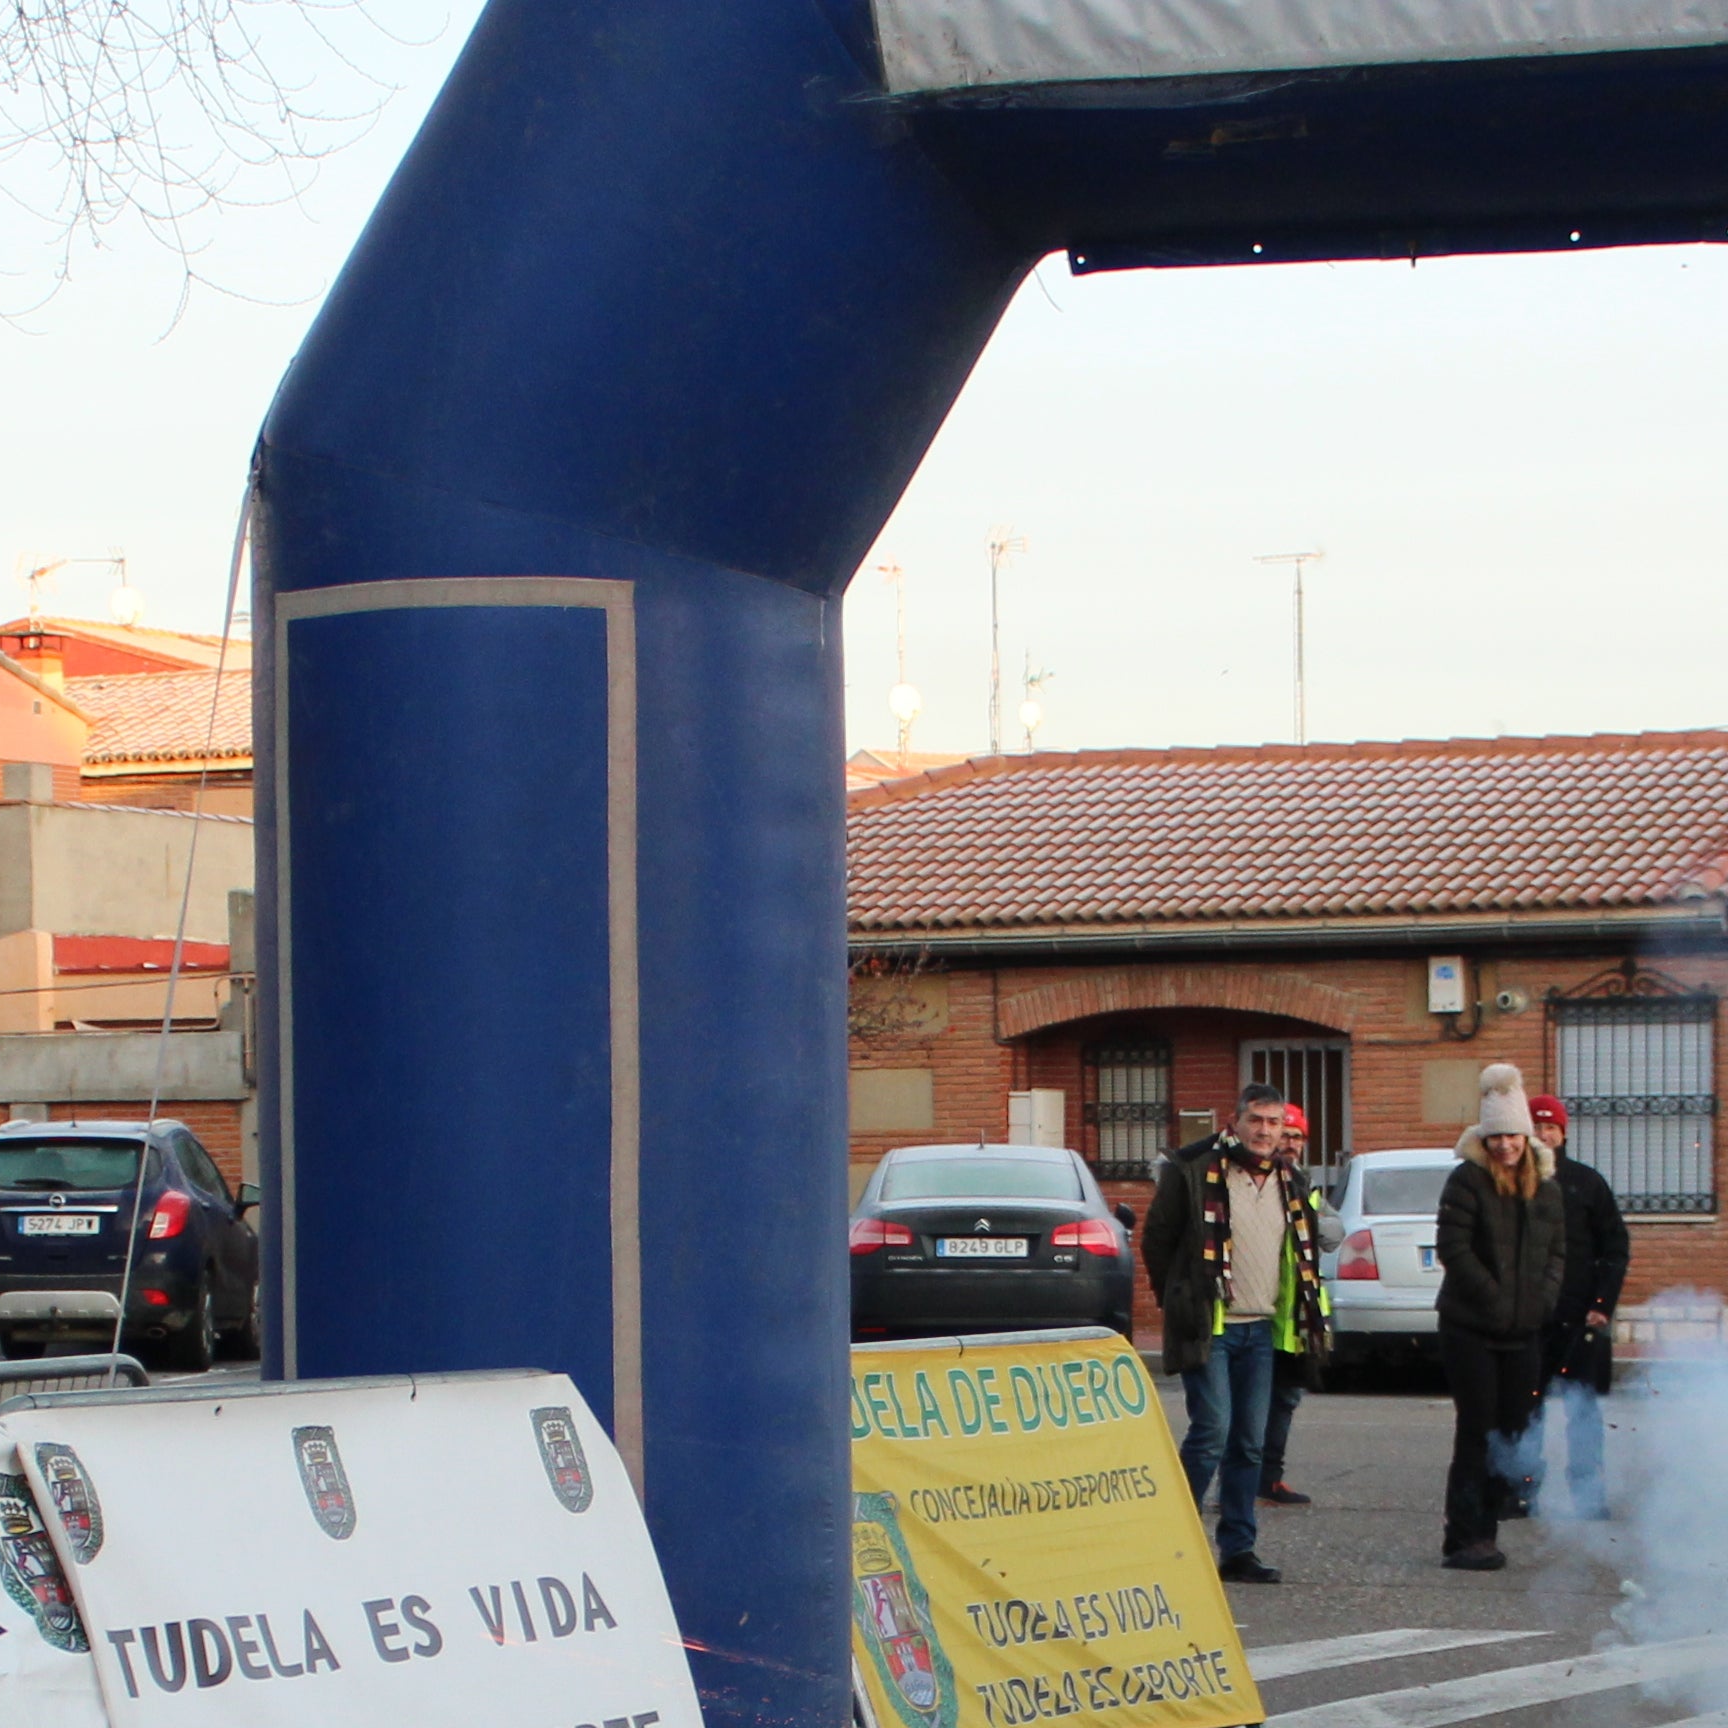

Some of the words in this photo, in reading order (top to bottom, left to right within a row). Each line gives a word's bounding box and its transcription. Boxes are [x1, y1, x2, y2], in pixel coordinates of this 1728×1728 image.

[28, 1218, 61, 1231] 5274
[948, 1240, 989, 1254] 8249
[994, 1240, 1024, 1254] GLP
[946, 1366, 1010, 1438] DE
[1008, 1354, 1147, 1434] DUERO
[1030, 1480, 1061, 1513] DE
[1060, 1465, 1158, 1510] DEPORTES
[110, 1610, 341, 1698] TUDELA
[364, 1596, 443, 1663] ES
[470, 1572, 617, 1642] VIDA
[966, 1598, 1076, 1649] TUDELA
[1073, 1593, 1109, 1641] ES
[1106, 1583, 1182, 1634] VIDA,
[975, 1670, 1085, 1728] TUDELA
[1080, 1666, 1121, 1711] ES
